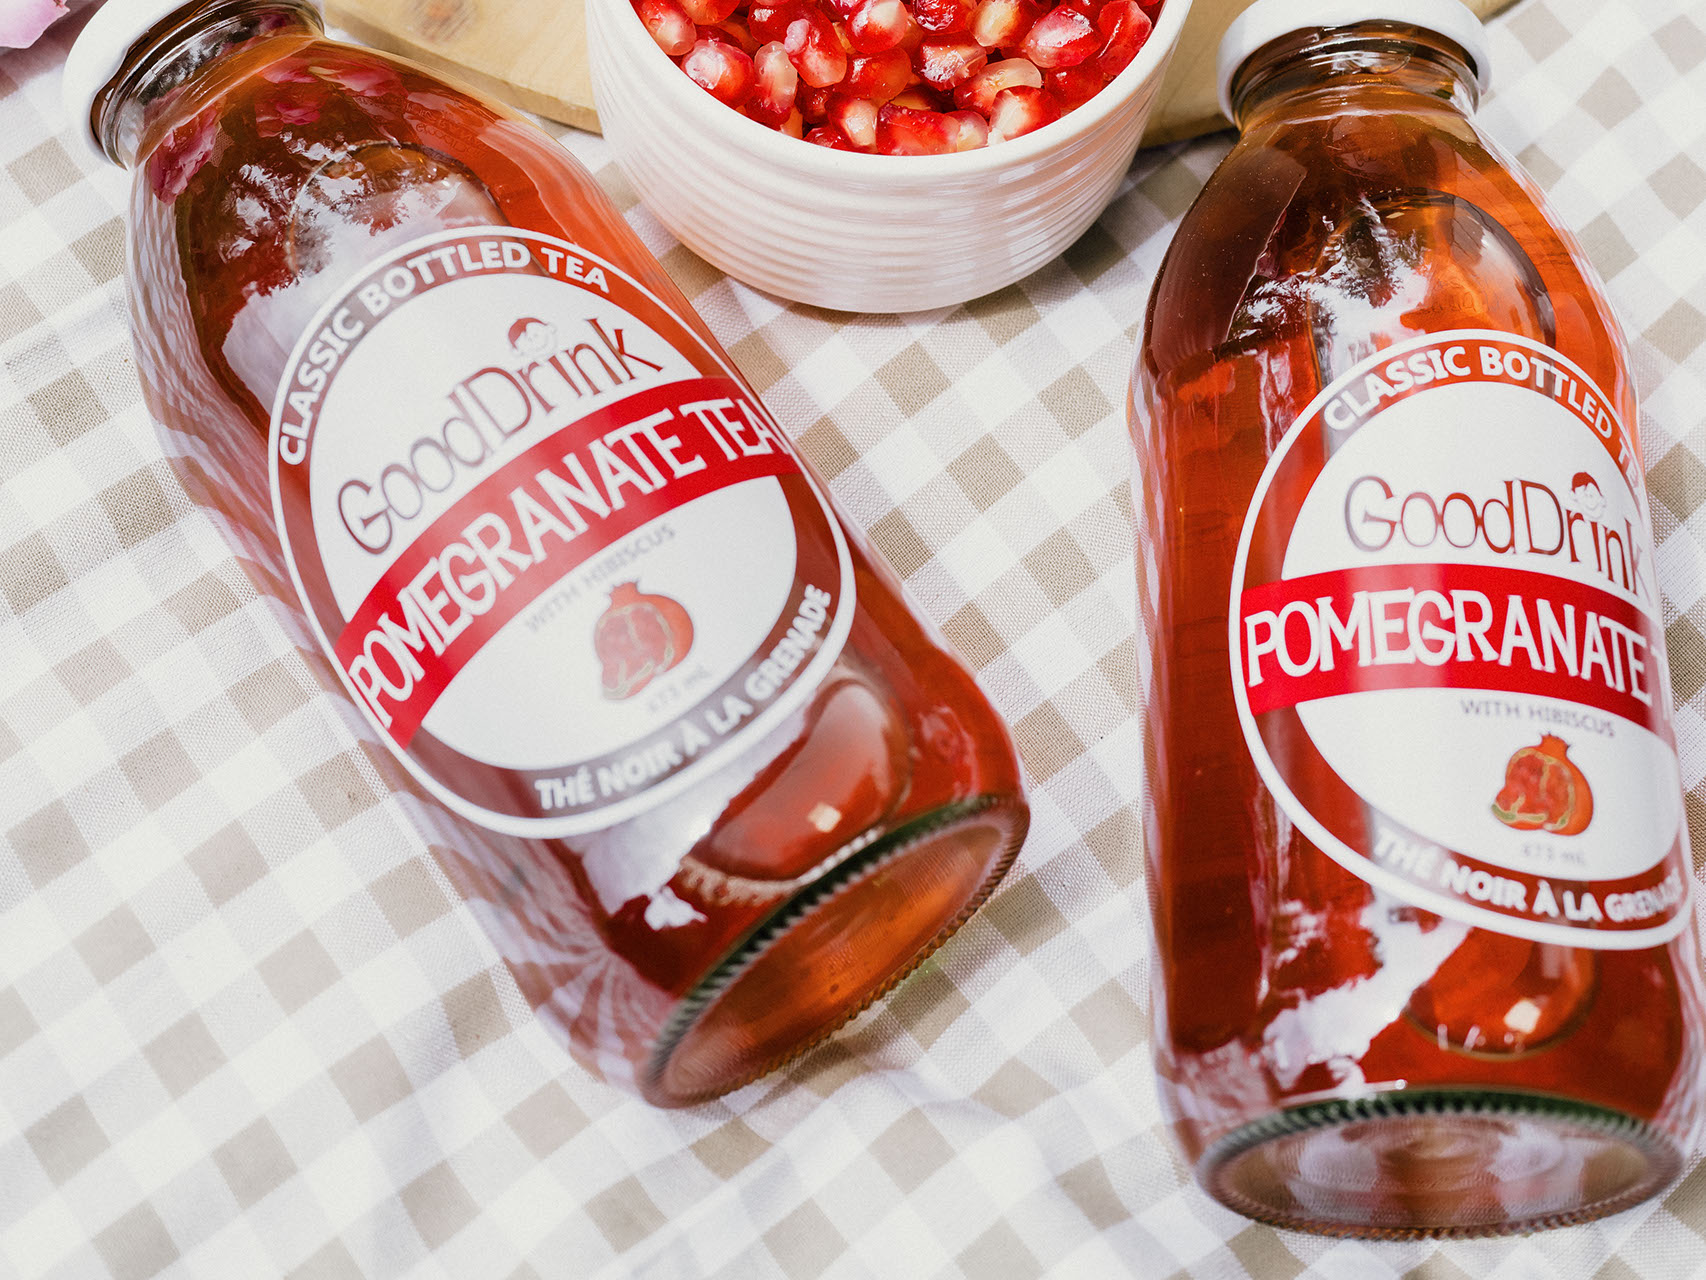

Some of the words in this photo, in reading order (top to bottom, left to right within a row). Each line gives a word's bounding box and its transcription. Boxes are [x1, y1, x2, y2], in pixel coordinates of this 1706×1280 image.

[279, 307, 364, 465] CLASSIC
[358, 241, 531, 317] BOTTLED
[540, 247, 610, 294] TEA
[1323, 345, 1471, 431] CLASSIC
[1479, 346, 1613, 440] BOTTLED
[336, 317, 664, 556] GoodDrink
[348, 407, 702, 731] POMEGRANATE
[693, 395, 792, 459] TEA
[1344, 475, 1652, 606] GoodDrink
[525, 588, 582, 633] WITH
[1244, 587, 1652, 706] POMEGRANATE
[534, 763, 596, 811] THÉ
[597, 739, 684, 797] NOIR
[704, 694, 753, 736] LA
[743, 583, 832, 701] GRENADE
[1460, 698, 1521, 720] WITH
[1527, 703, 1617, 738] HIBISCUS
[1440, 860, 1527, 912] NOIR
[1533, 880, 1560, 919] À
[1562, 890, 1602, 922] LA
